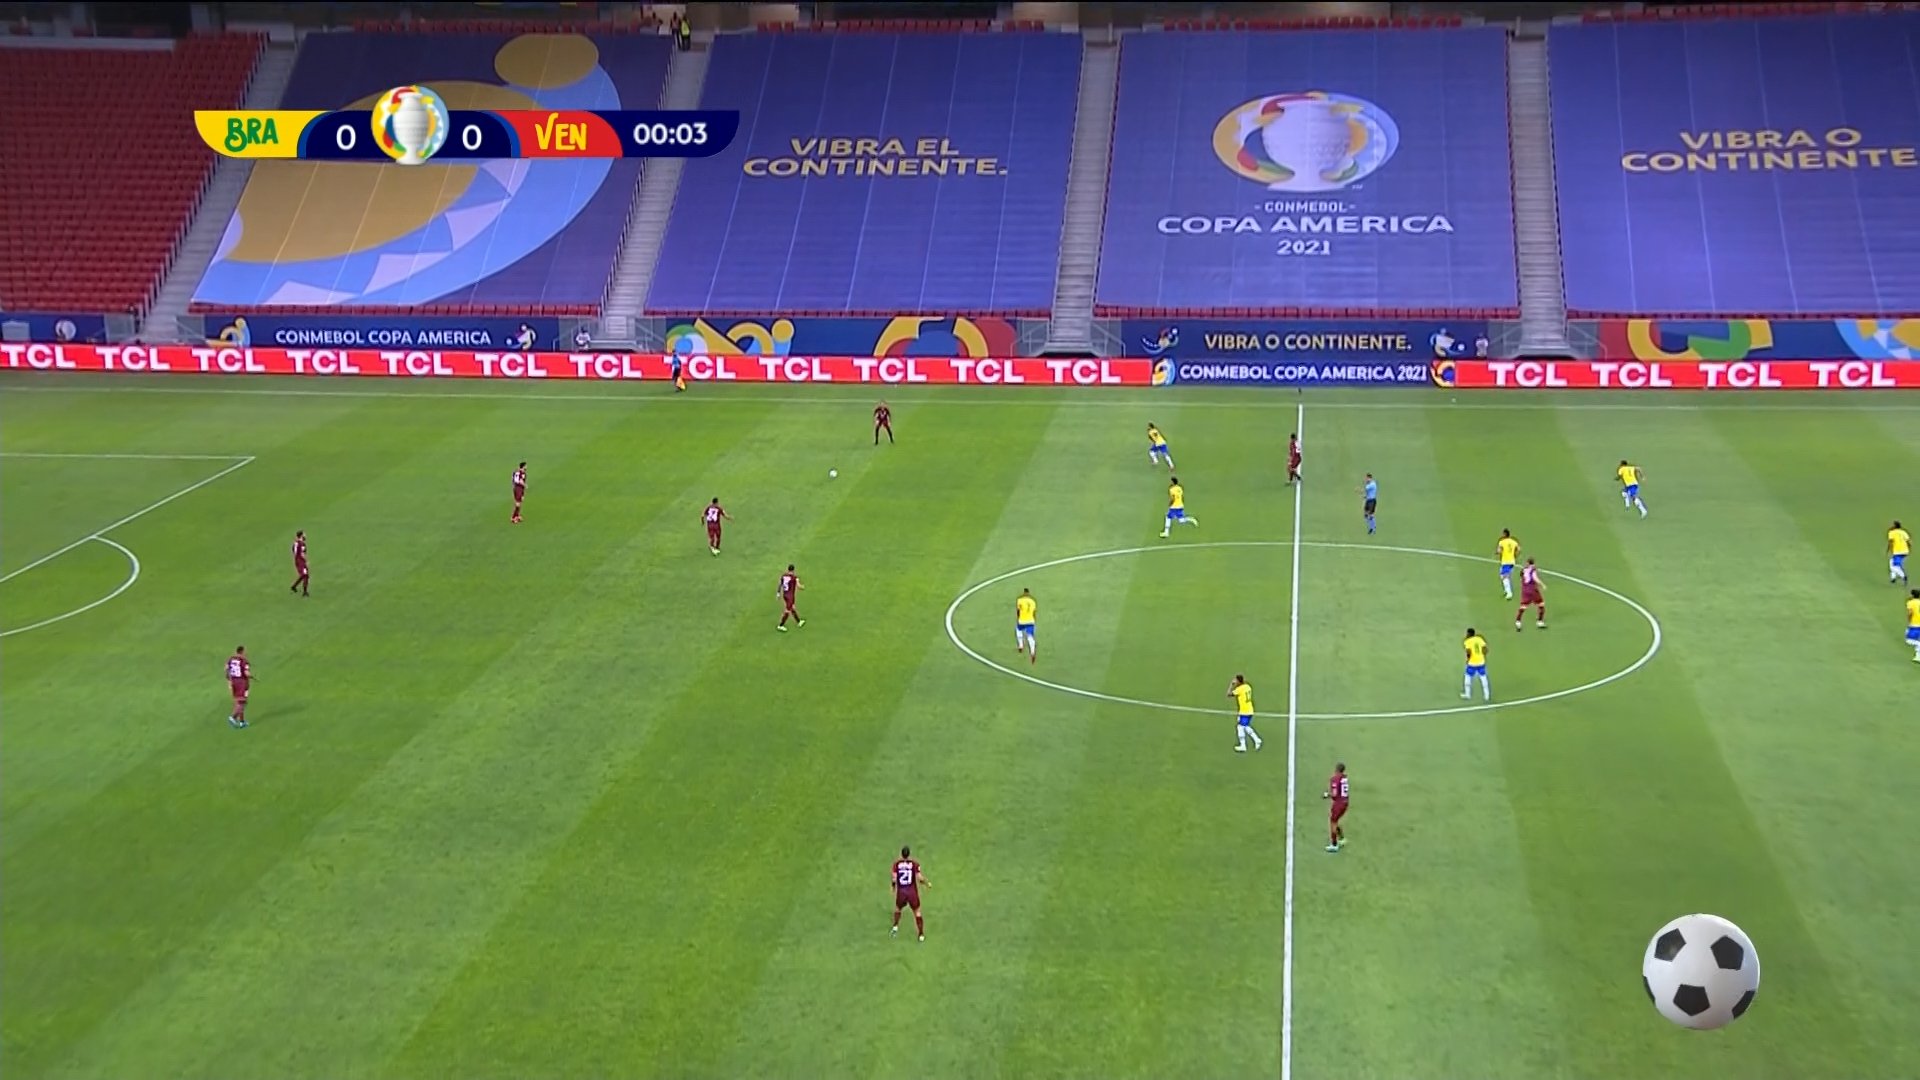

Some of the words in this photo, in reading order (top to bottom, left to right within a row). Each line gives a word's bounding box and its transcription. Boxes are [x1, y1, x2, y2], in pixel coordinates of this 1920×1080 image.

[791, 138, 906, 156] VIBRA
[917, 138, 959, 156] EL
[1680, 129, 1817, 149] VIBRA
[1825, 127, 1862, 147] O
[743, 158, 1008, 176] CONTINENTE.
[1157, 216, 1262, 233] COPA
[1270, 215, 1454, 233] AMERICA
[1276, 240, 1331, 255] 2021
[275, 329, 364, 345] CONMEBOL
[368, 330, 413, 346] COPA
[416, 330, 491, 346] AMERICA
[1204, 334, 1260, 351] VIBRA
[1265, 334, 1280, 351] O
[1284, 334, 1412, 351] CONTINENTE.
[0, 344, 76, 369] TCL
[96, 346, 170, 370] TCL
[192, 348, 265, 372] TCL
[287, 350, 360, 375] TCL
[381, 351, 453, 376] TCL
[475, 352, 548, 377] TCL
[569, 353, 642, 378] TCL
[759, 356, 832, 381] TCL
[853, 357, 927, 382] TCL
[950, 358, 1024, 383] TCL
[1047, 358, 1121, 384] TCL
[1179, 364, 1271, 380] CONMEBOL
[1273, 364, 1321, 380] COPA
[1321, 364, 1394, 380] AMERICA
[1397, 364, 1428, 381] 2021
[1487, 362, 1567, 387] TCL
[1591, 362, 1673, 387] TCL
[1700, 362, 1782, 387] TCL
[1810, 362, 1896, 387] TCL
[898, 870, 913, 885] 21
